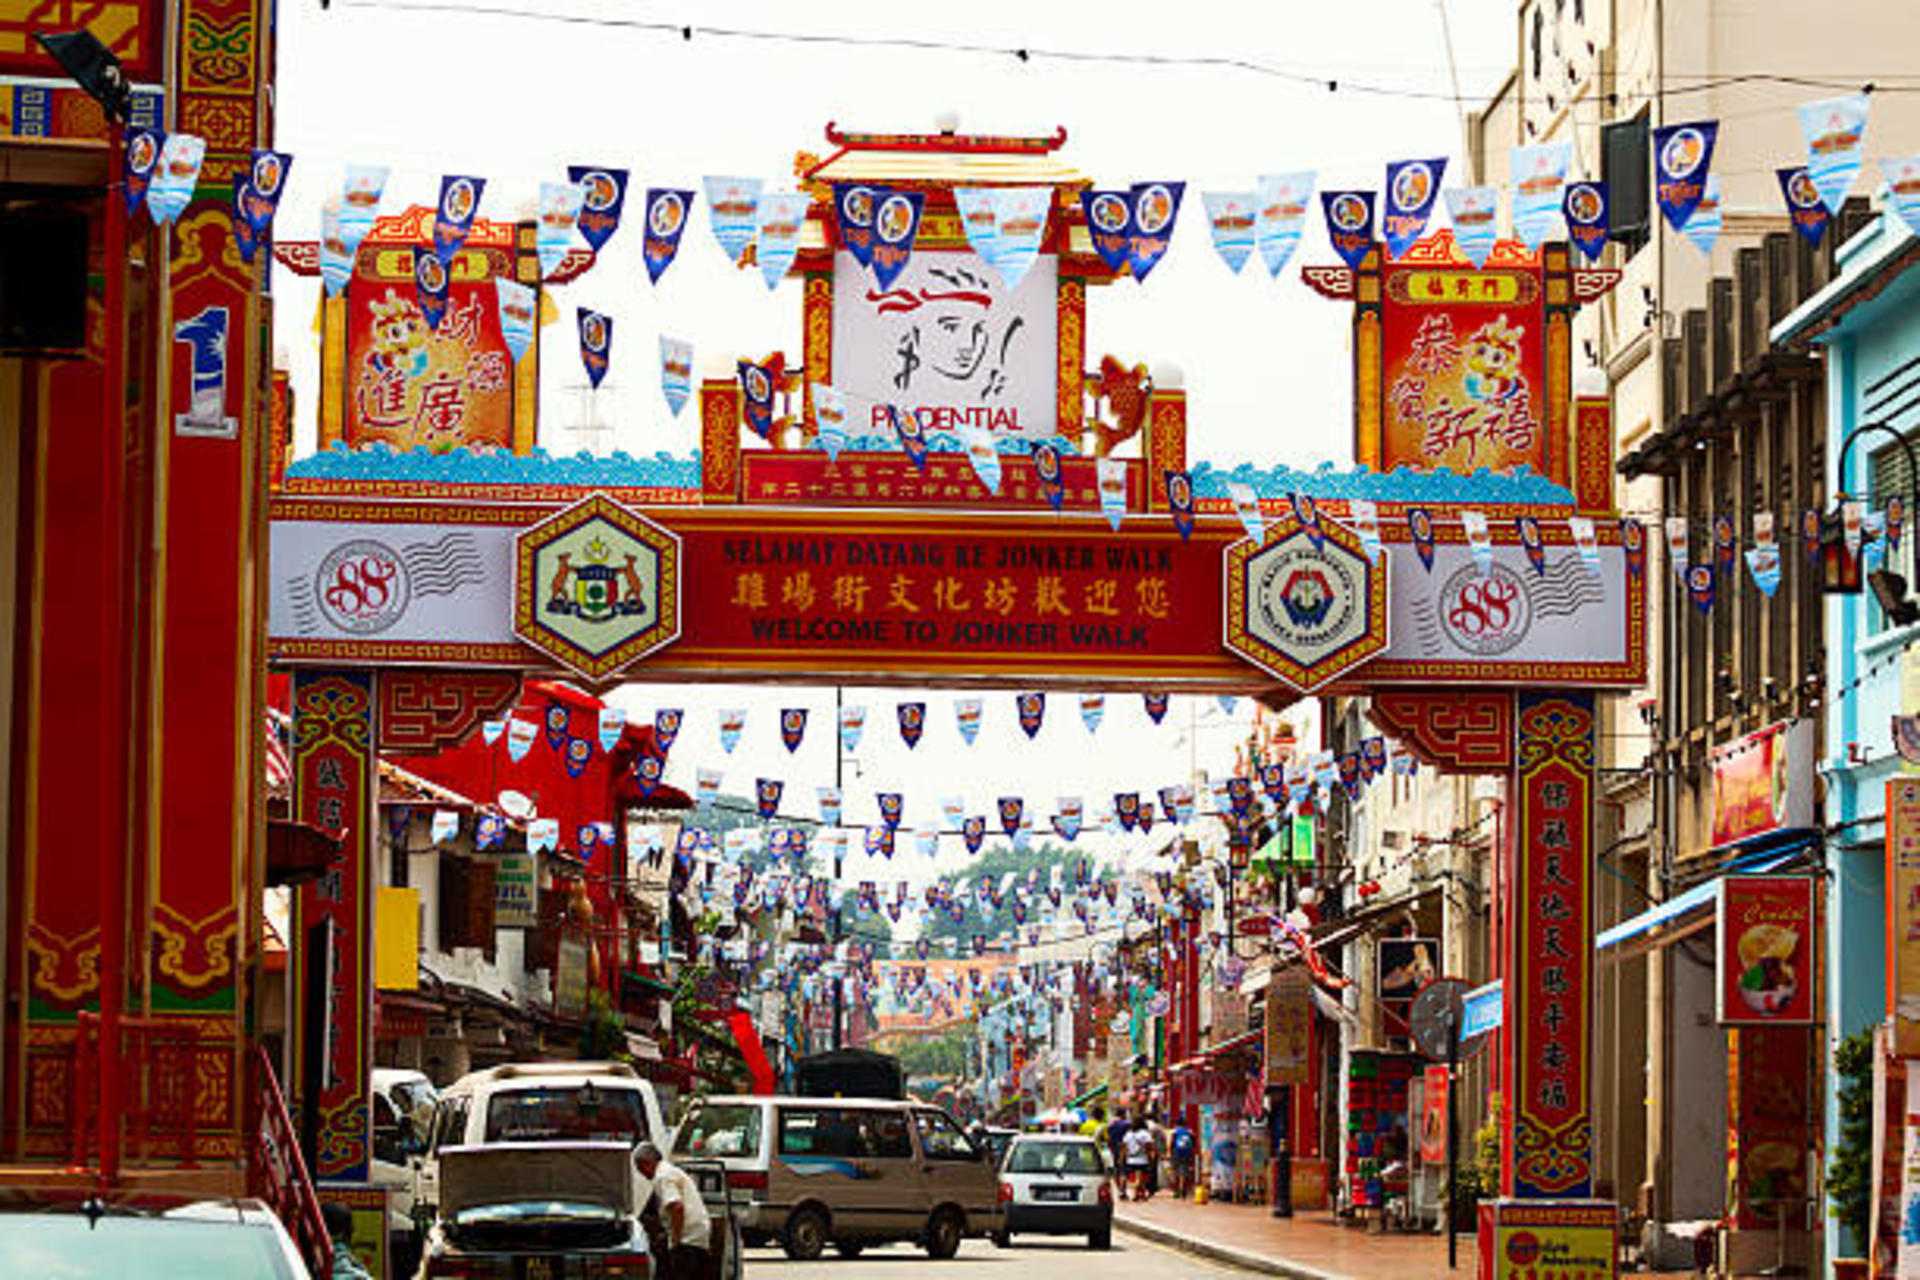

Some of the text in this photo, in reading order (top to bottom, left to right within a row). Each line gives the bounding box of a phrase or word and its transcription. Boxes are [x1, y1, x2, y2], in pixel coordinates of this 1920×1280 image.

[871, 405, 1024, 431] PDENTIAL
[725, 539, 1172, 572] SELAMAT DATANG KE JONKER WALK
[751, 616, 1149, 649] WELCOME TO JONKER WALK
